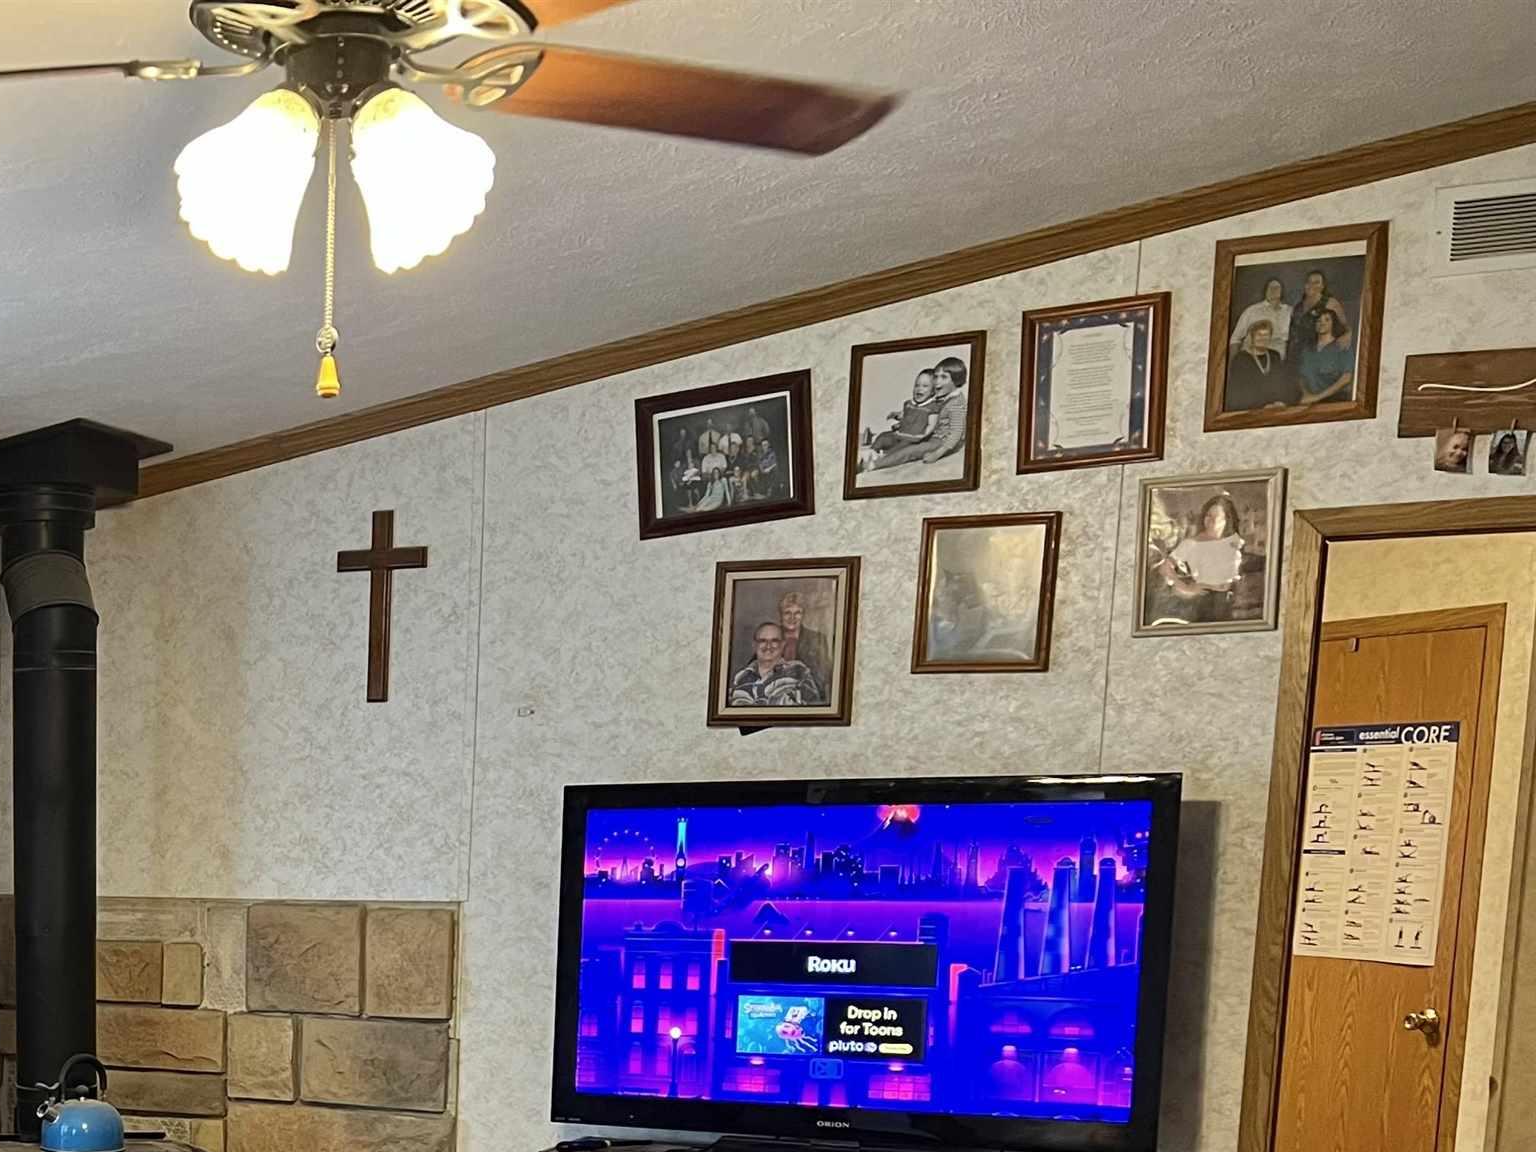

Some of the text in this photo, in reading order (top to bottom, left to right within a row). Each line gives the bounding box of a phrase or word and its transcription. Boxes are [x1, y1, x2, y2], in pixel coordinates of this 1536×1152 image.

[1358, 726, 1401, 741] essential
[1400, 725, 1452, 745] CORE
[847, 1005, 898, 1022] Drop in
[839, 1021, 904, 1037] for Toons
[828, 1040, 864, 1054] pluto
[815, 1119, 850, 1129] ORION
